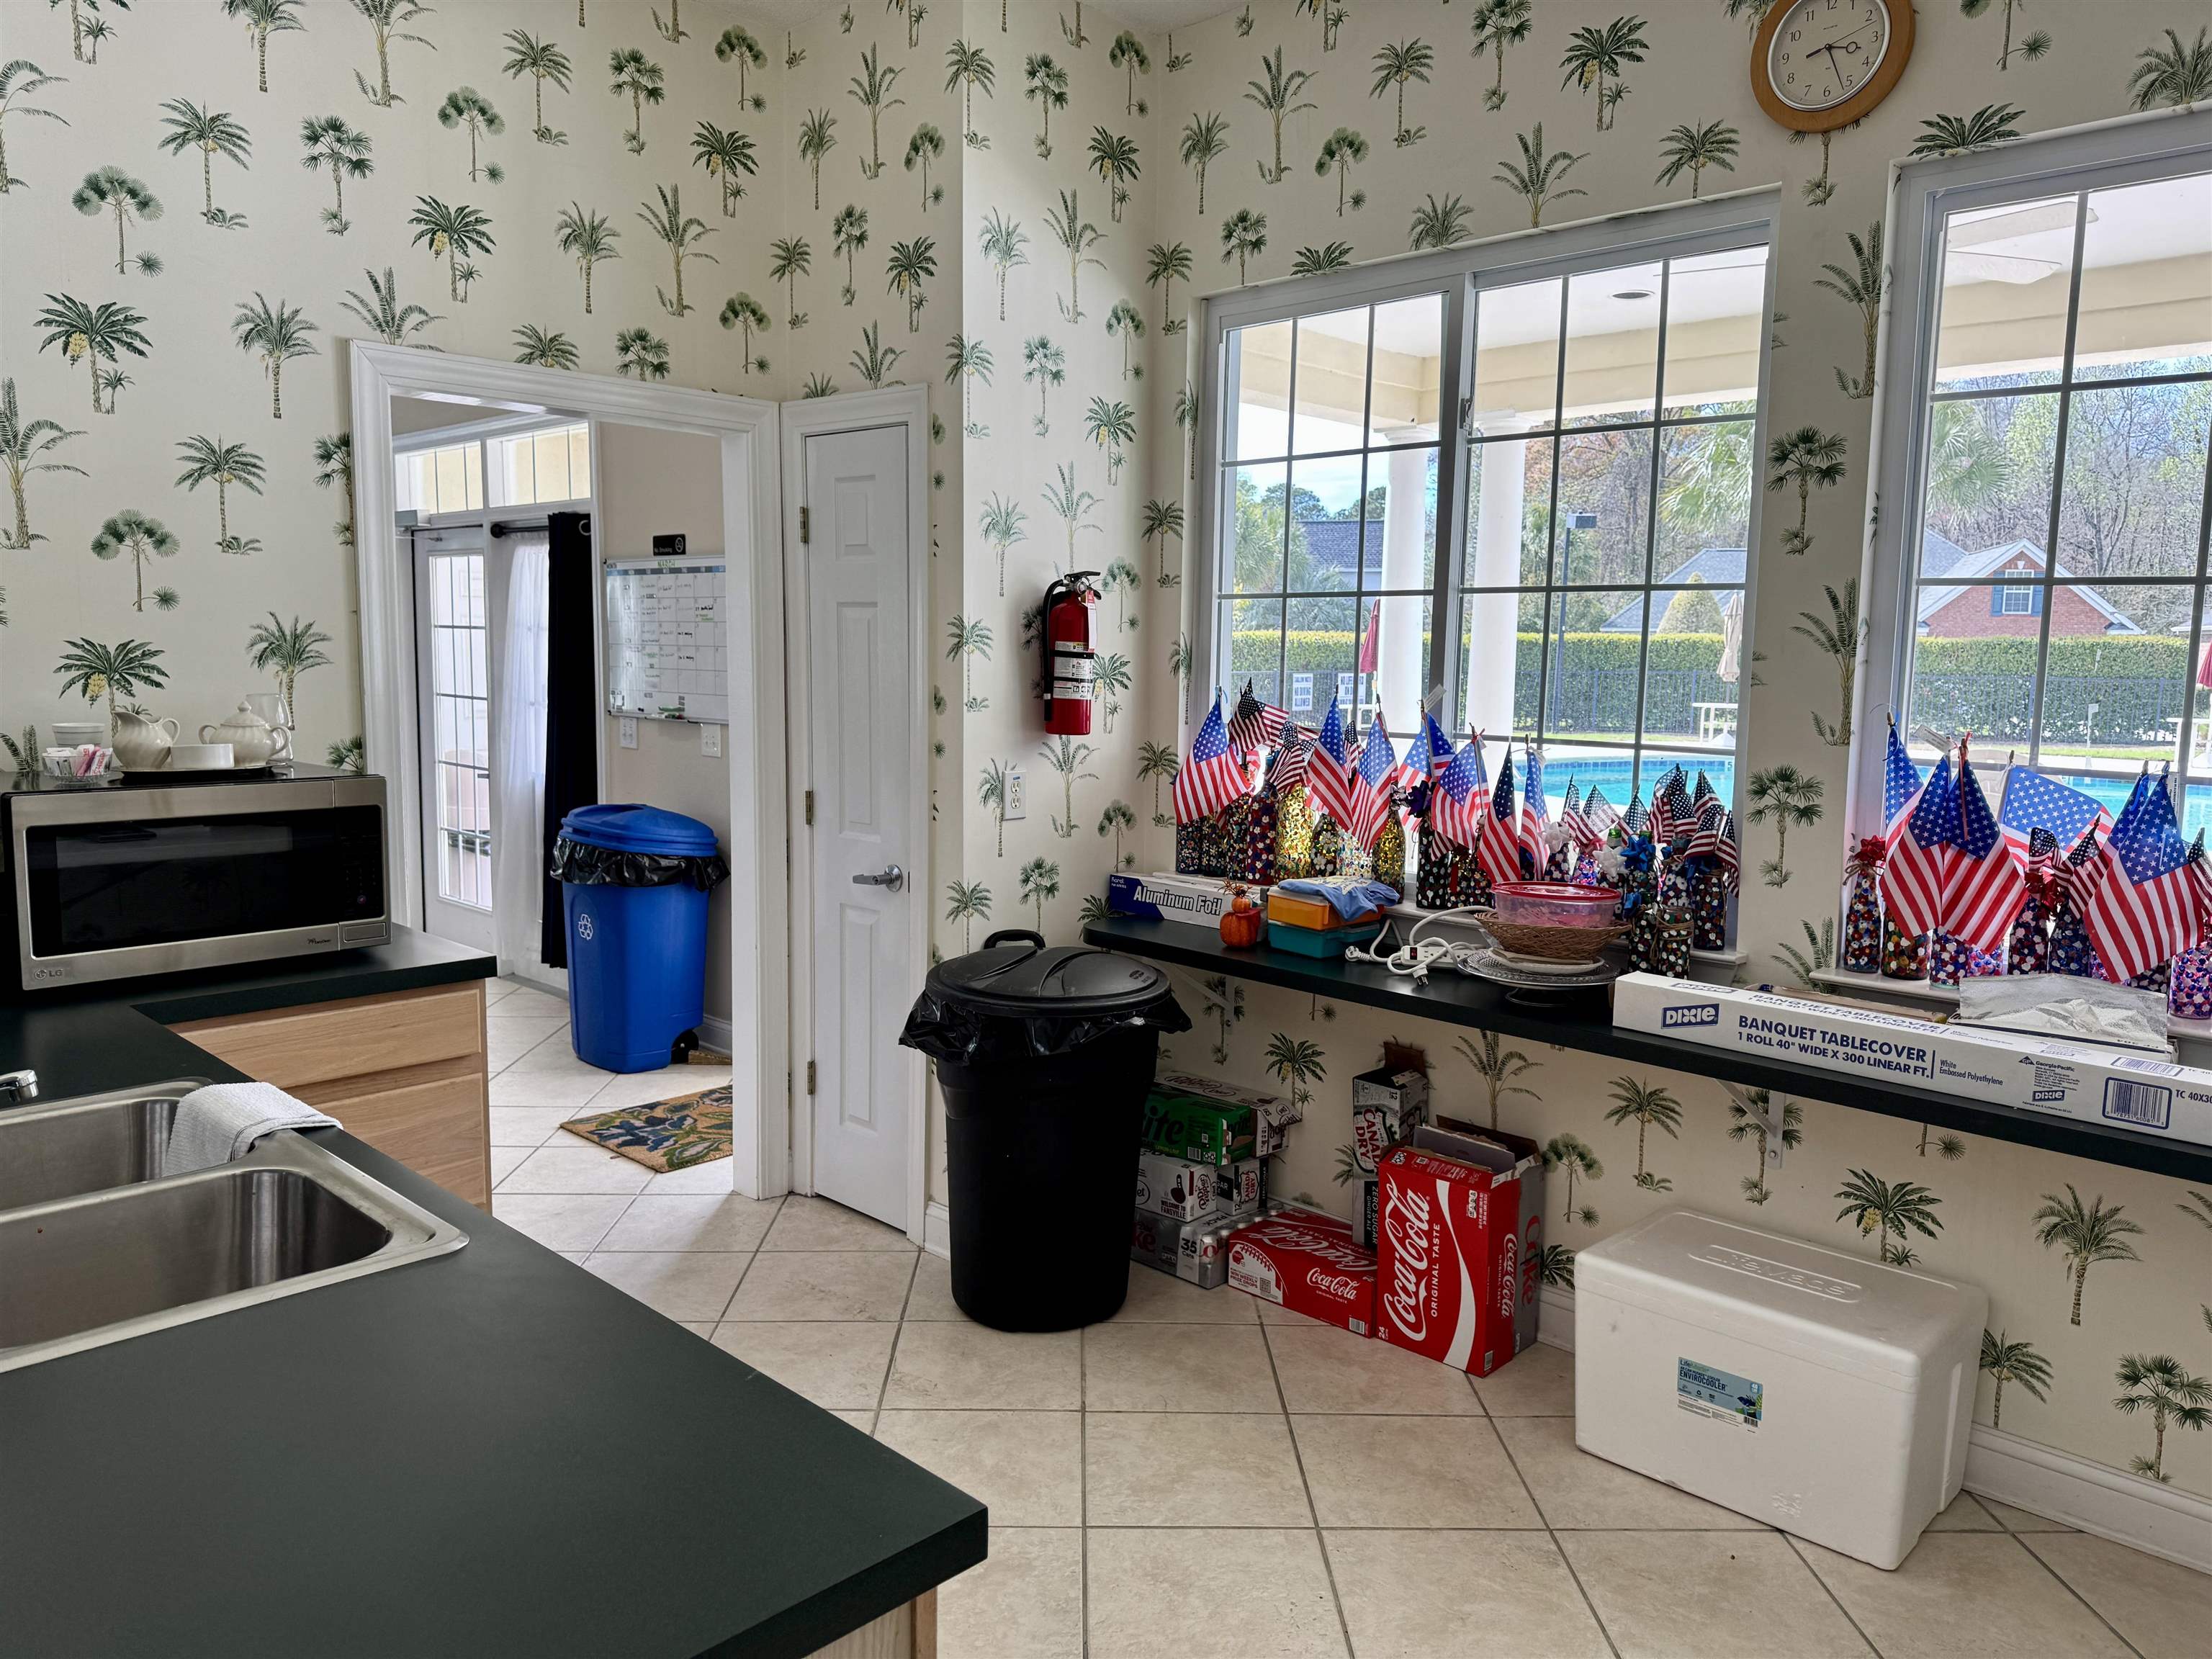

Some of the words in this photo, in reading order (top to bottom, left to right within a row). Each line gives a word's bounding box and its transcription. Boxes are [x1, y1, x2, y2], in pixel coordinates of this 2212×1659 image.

[1826, 0, 1838, 10] 12
[1805, 10, 1814, 22] 11
[1865, 9, 1873, 22] 2
[1789, 30, 1801, 42] 10
[1871, 31, 1879, 42] 3
[1782, 53, 1789, 65] 9
[1861, 55, 1869, 67] 4
[1787, 72, 1794, 84] 8
[1845, 74, 1853, 87] 5
[1804, 84, 1812, 97] 7
[1823, 85, 1830, 97] 6
[1133, 886, 1194, 911] Aluminum
[1196, 895, 1223, 916] Foil
[49, 969, 63, 979] LG
[1738, 1015, 1817, 1042] BANQUET
[1820, 1032, 1927, 1063] TABLECOVER
[1737, 1030, 1743, 1040] 1
[1746, 1033, 1774, 1048] ROLL
[1776, 1038, 1797, 1051] 40"
[1798, 1042, 1828, 1058] WIDE
[1830, 1049, 1840, 1059] X
[1842, 1051, 1865, 1065] 300
[1867, 1055, 1911, 1074] LINEAR
[1913, 1064, 1930, 1079] FT.
[1940, 1059, 1956, 1069] White
[2036, 1060, 2075, 1072] Georgia-Pacific
[1939, 1066, 1966, 1079] Embossed
[1967, 1071, 2003, 1087] Polyethylene
[2175, 1089, 2186, 1099] TC
[1355, 1126, 1371, 1164] DRY
[1161, 1200, 1180, 1210] WELCOME
[1234, 1203, 1241, 1212] 12
[1160, 1206, 1187, 1220] FANSVILLE
[1181, 1238, 1197, 1254] 35
[1431, 1223, 1440, 1261] TASTE
[1230, 1275, 1242, 1285] PRIZE
[1242, 1279, 1258, 1289] DROPS
[1239, 1272, 1258, 1284] WEEKLY
[1430, 1264, 1439, 1318] ORIGINAL
[1378, 1326, 1385, 1339] 24
[1679, 1370, 1726, 1392] ENVIROCOOLER
